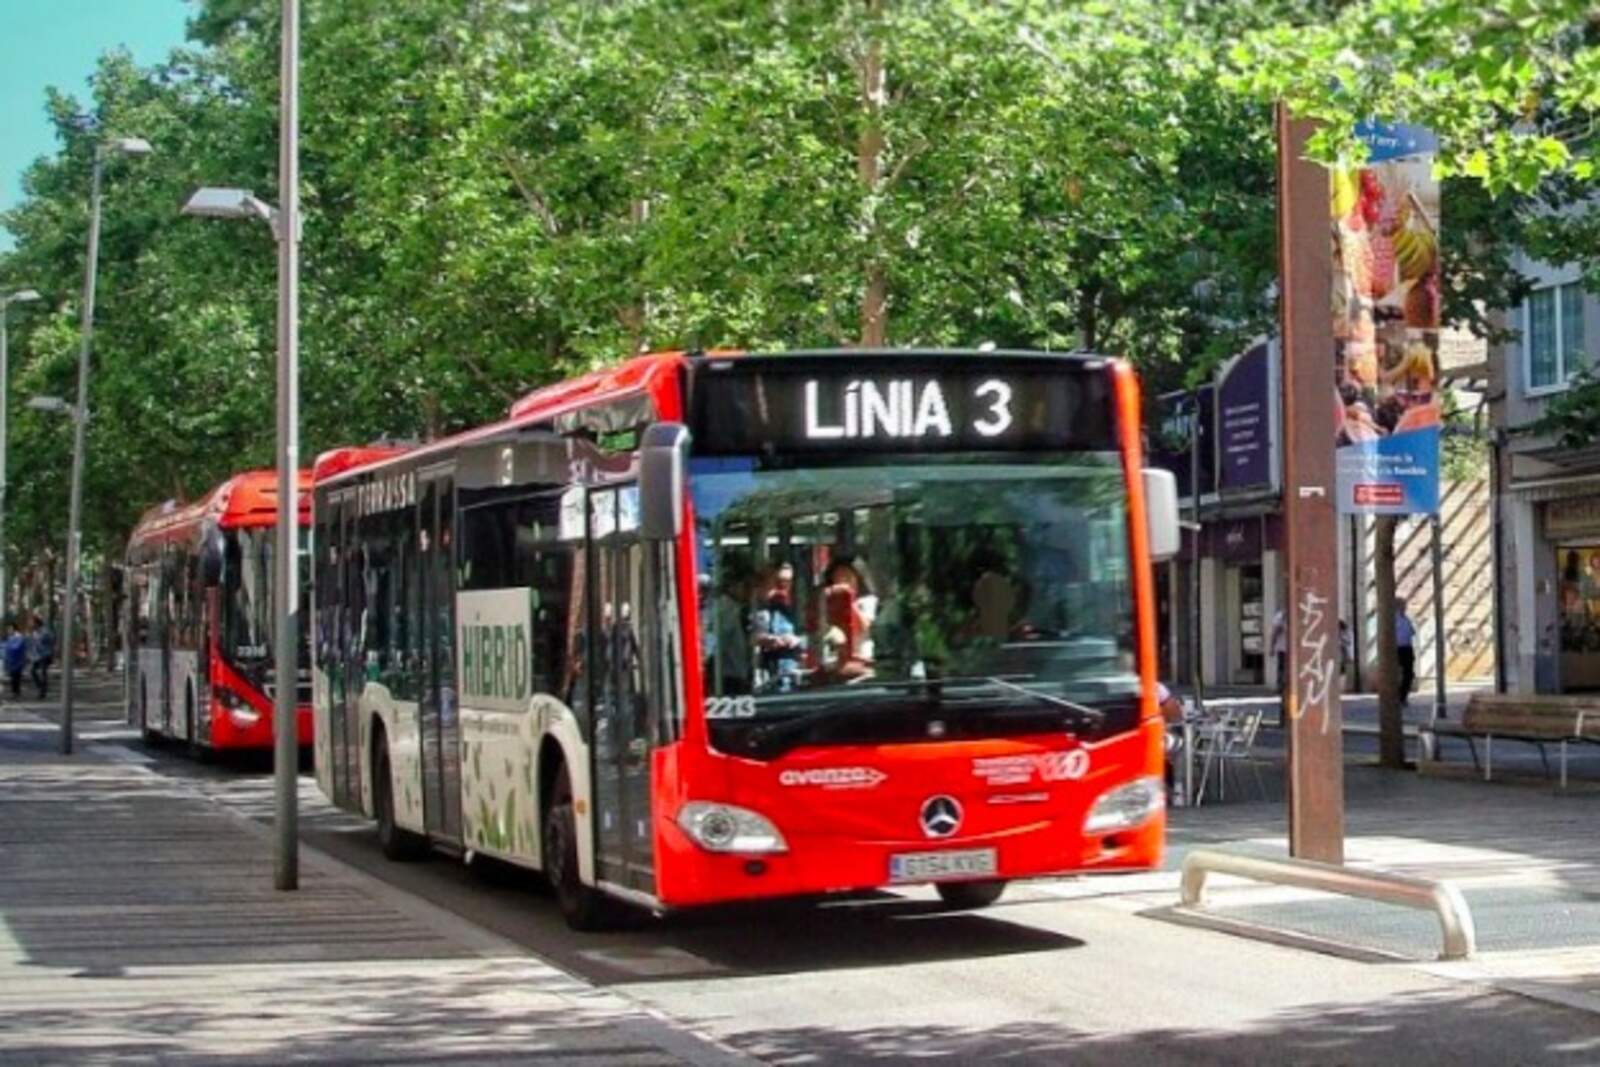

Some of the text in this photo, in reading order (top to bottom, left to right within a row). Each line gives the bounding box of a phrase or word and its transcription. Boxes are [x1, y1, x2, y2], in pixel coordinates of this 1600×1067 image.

[973, 379, 1013, 436] 3
[357, 471, 416, 518] TERRASSA
[704, 694, 757, 719] 2213
